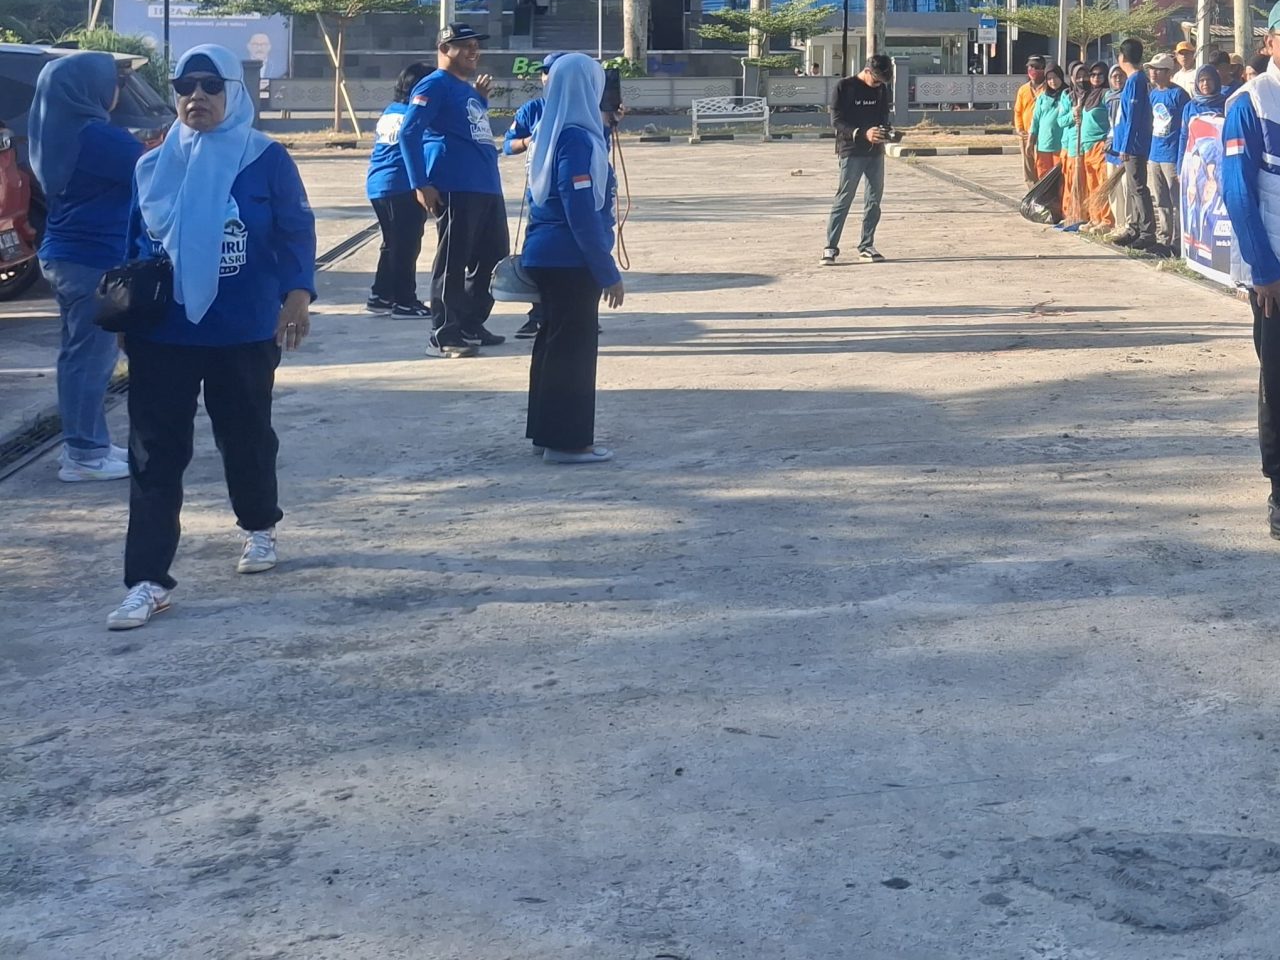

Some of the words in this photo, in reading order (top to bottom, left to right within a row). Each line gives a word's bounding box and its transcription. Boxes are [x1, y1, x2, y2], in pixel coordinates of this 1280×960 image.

[512, 57, 541, 75] Ba
[221, 240, 245, 254] IRU
[220, 253, 245, 265] ASRI
